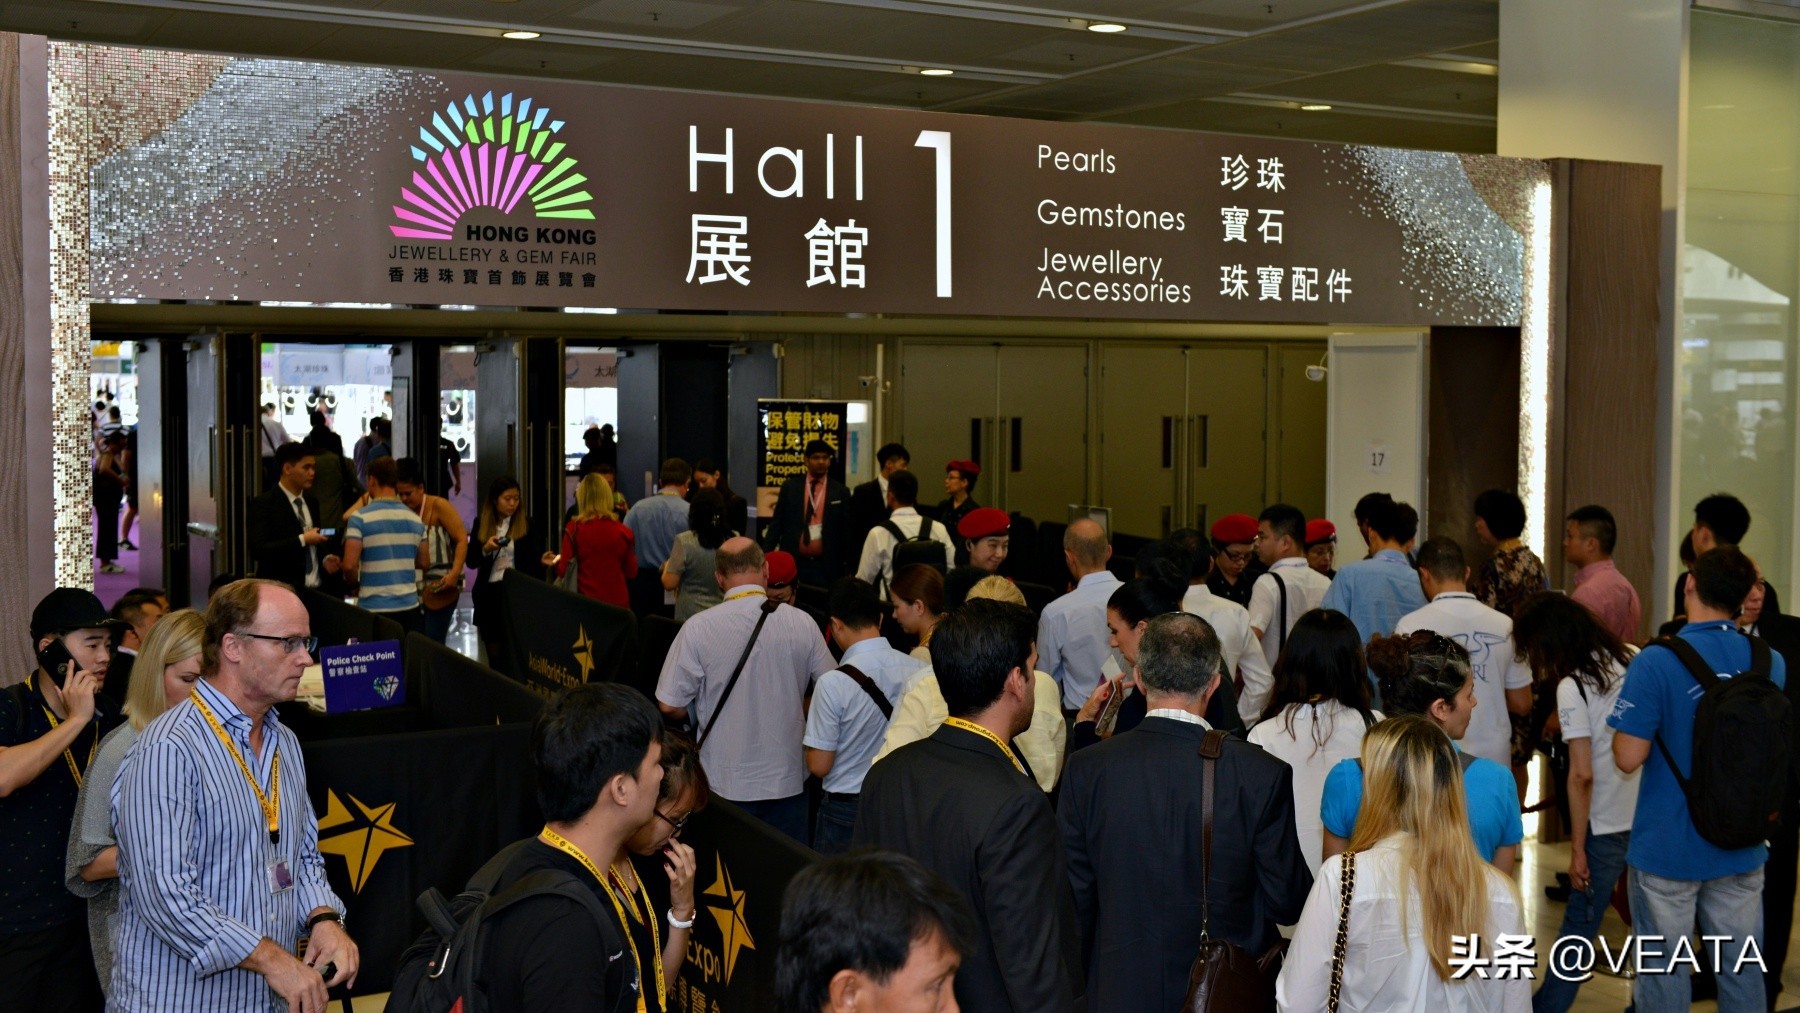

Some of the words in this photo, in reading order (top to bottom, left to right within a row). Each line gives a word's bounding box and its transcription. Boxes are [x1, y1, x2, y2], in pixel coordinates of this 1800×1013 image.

[690, 125, 863, 200] Hall
[1038, 144, 1116, 174] Pearls
[1220, 154, 1286, 193] 珍珠
[914, 130, 952, 297] 1
[1037, 199, 1186, 231] Gemstones
[1220, 206, 1285, 244] 寶石
[466, 225, 529, 243] HONG
[536, 227, 597, 245] KONG
[389, 245, 492, 262] JEWELLERY
[499, 249, 510, 263] &
[517, 250, 553, 265] GEM
[561, 252, 597, 266] FAIR
[685, 214, 868, 288] 展館
[1037, 247, 1163, 281] Jewellery
[388, 266, 597, 288] 香港珠寶首飾展覽會
[1037, 276, 1191, 303] Accessories
[1219, 264, 1352, 303] 珠寶配件
[768, 411, 839, 430] 保管財物
[766, 452, 805, 463] Protect
[1372, 453, 1384, 466] 17
[327, 657, 350, 666] Police
[352, 653, 374, 663] Check
[376, 651, 396, 660] Point
